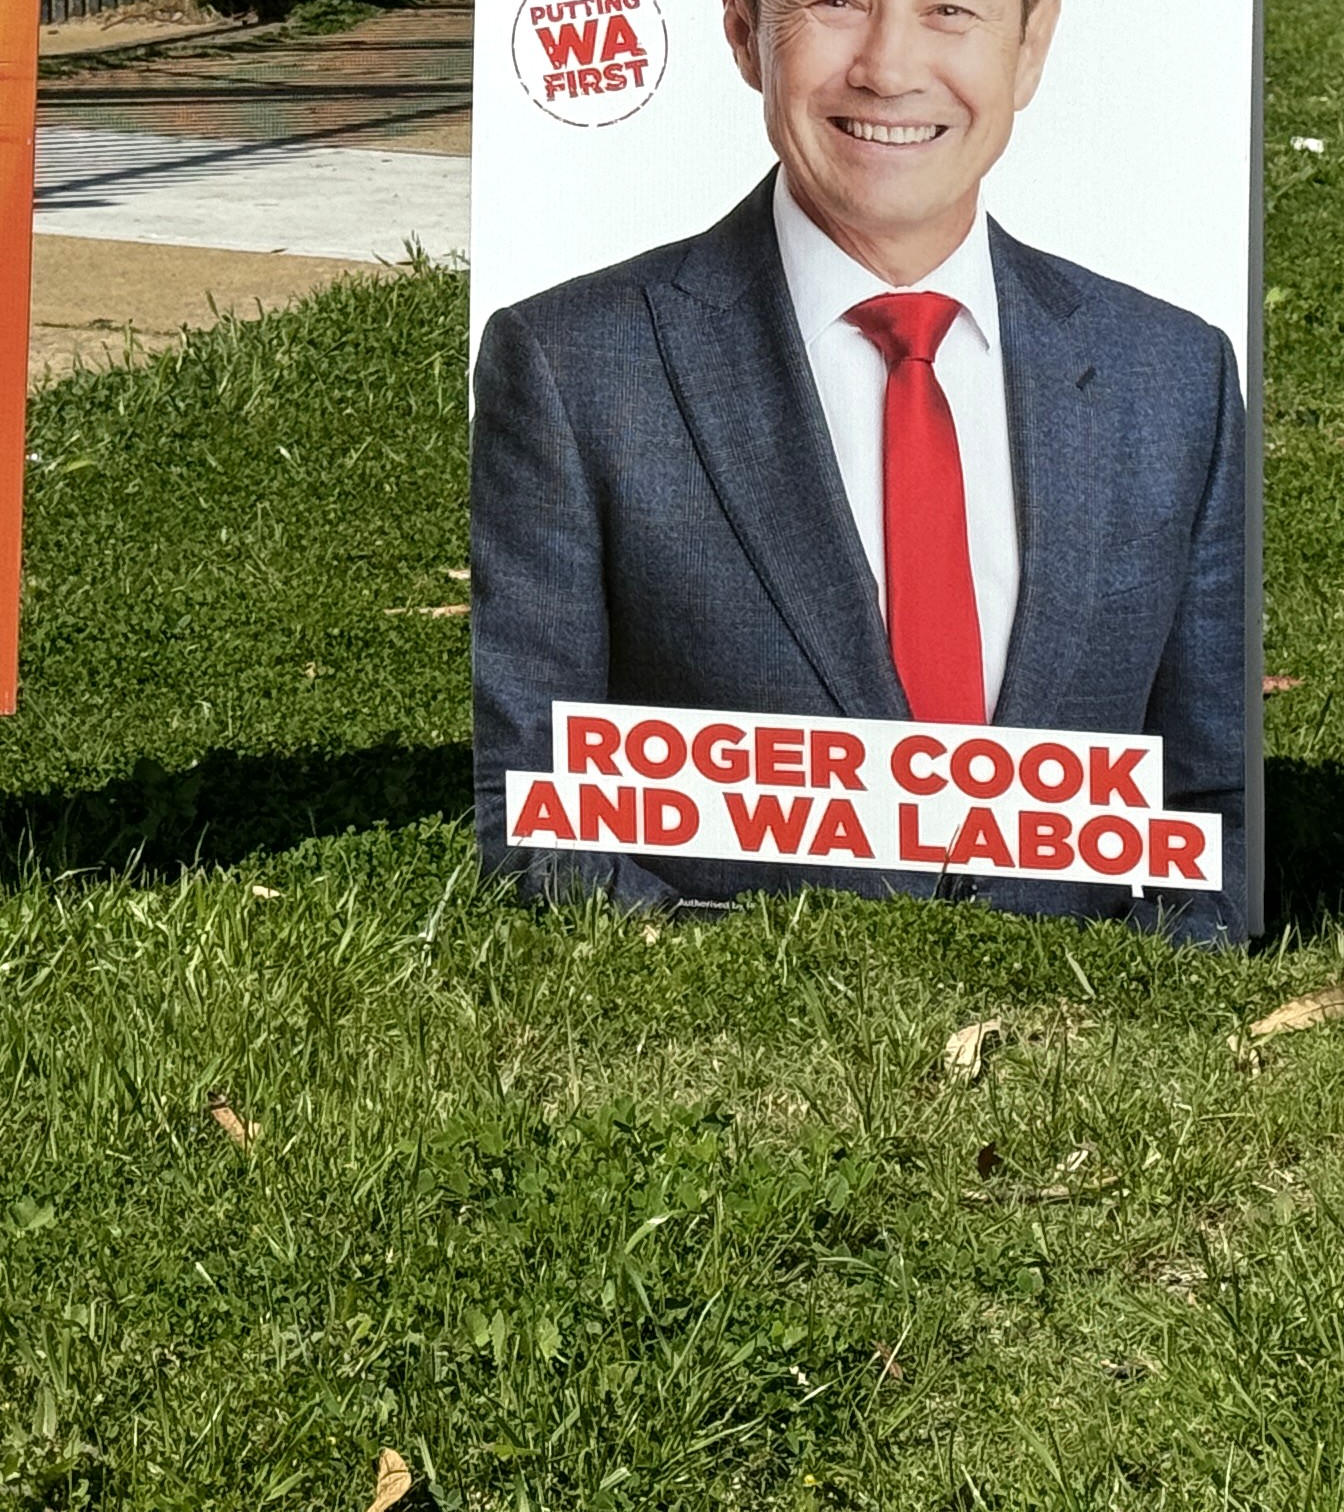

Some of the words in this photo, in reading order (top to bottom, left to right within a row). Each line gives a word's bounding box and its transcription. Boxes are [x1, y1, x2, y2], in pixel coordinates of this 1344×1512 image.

[535, 13, 647, 71] WA
[543, 58, 649, 102] FIRST
[567, 715, 868, 792] ROGER
[890, 734, 1151, 809] COOK
[512, 780, 701, 846] AND
[722, 791, 876, 859] WA
[898, 802, 1208, 881] LABOR
